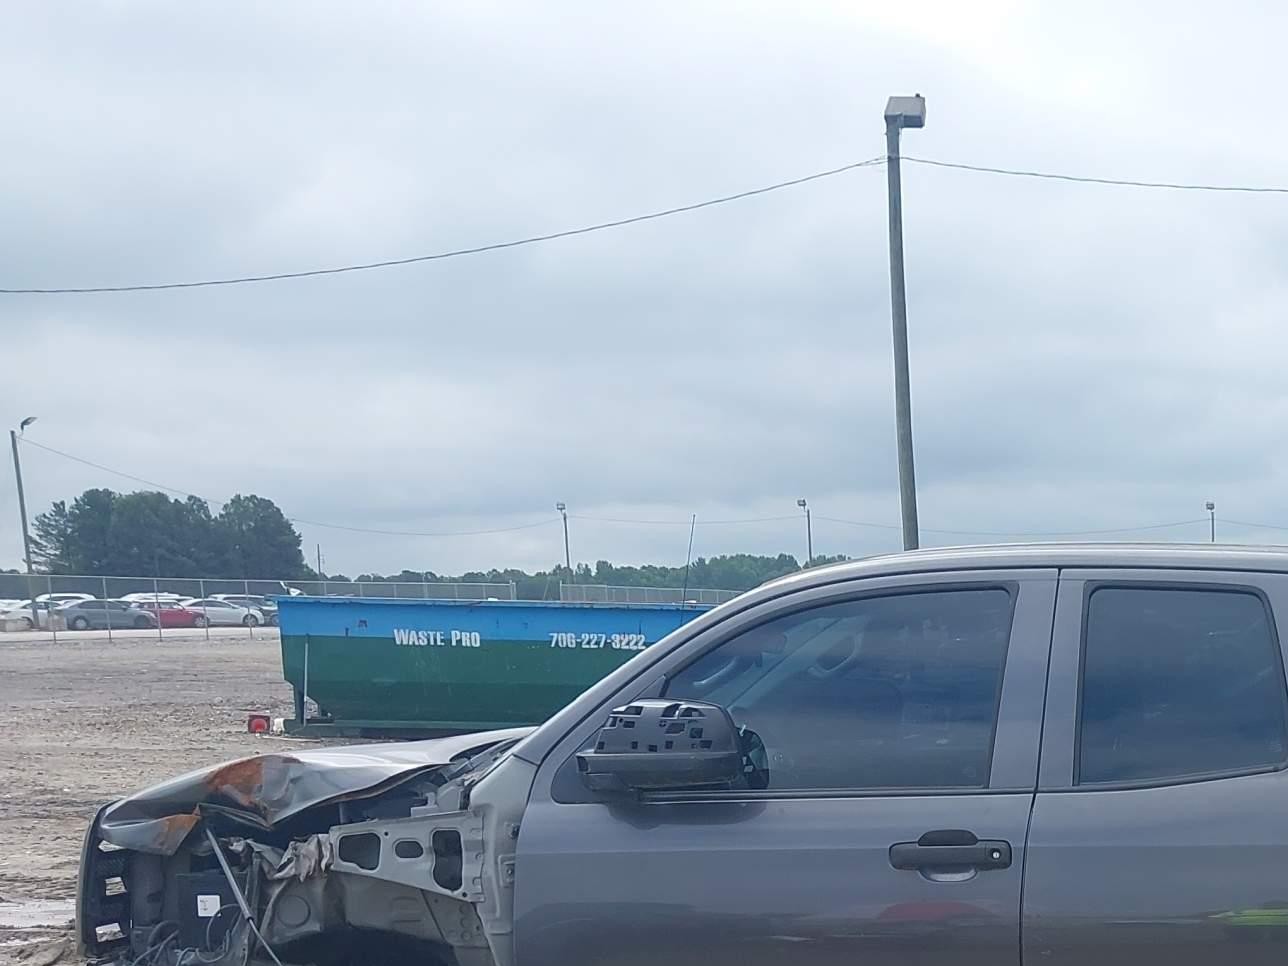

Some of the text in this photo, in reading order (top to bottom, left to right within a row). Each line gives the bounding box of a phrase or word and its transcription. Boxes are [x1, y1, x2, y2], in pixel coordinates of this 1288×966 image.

[393, 628, 481, 648] WASTE PRO
[549, 633, 646, 650] 706-227-3222
